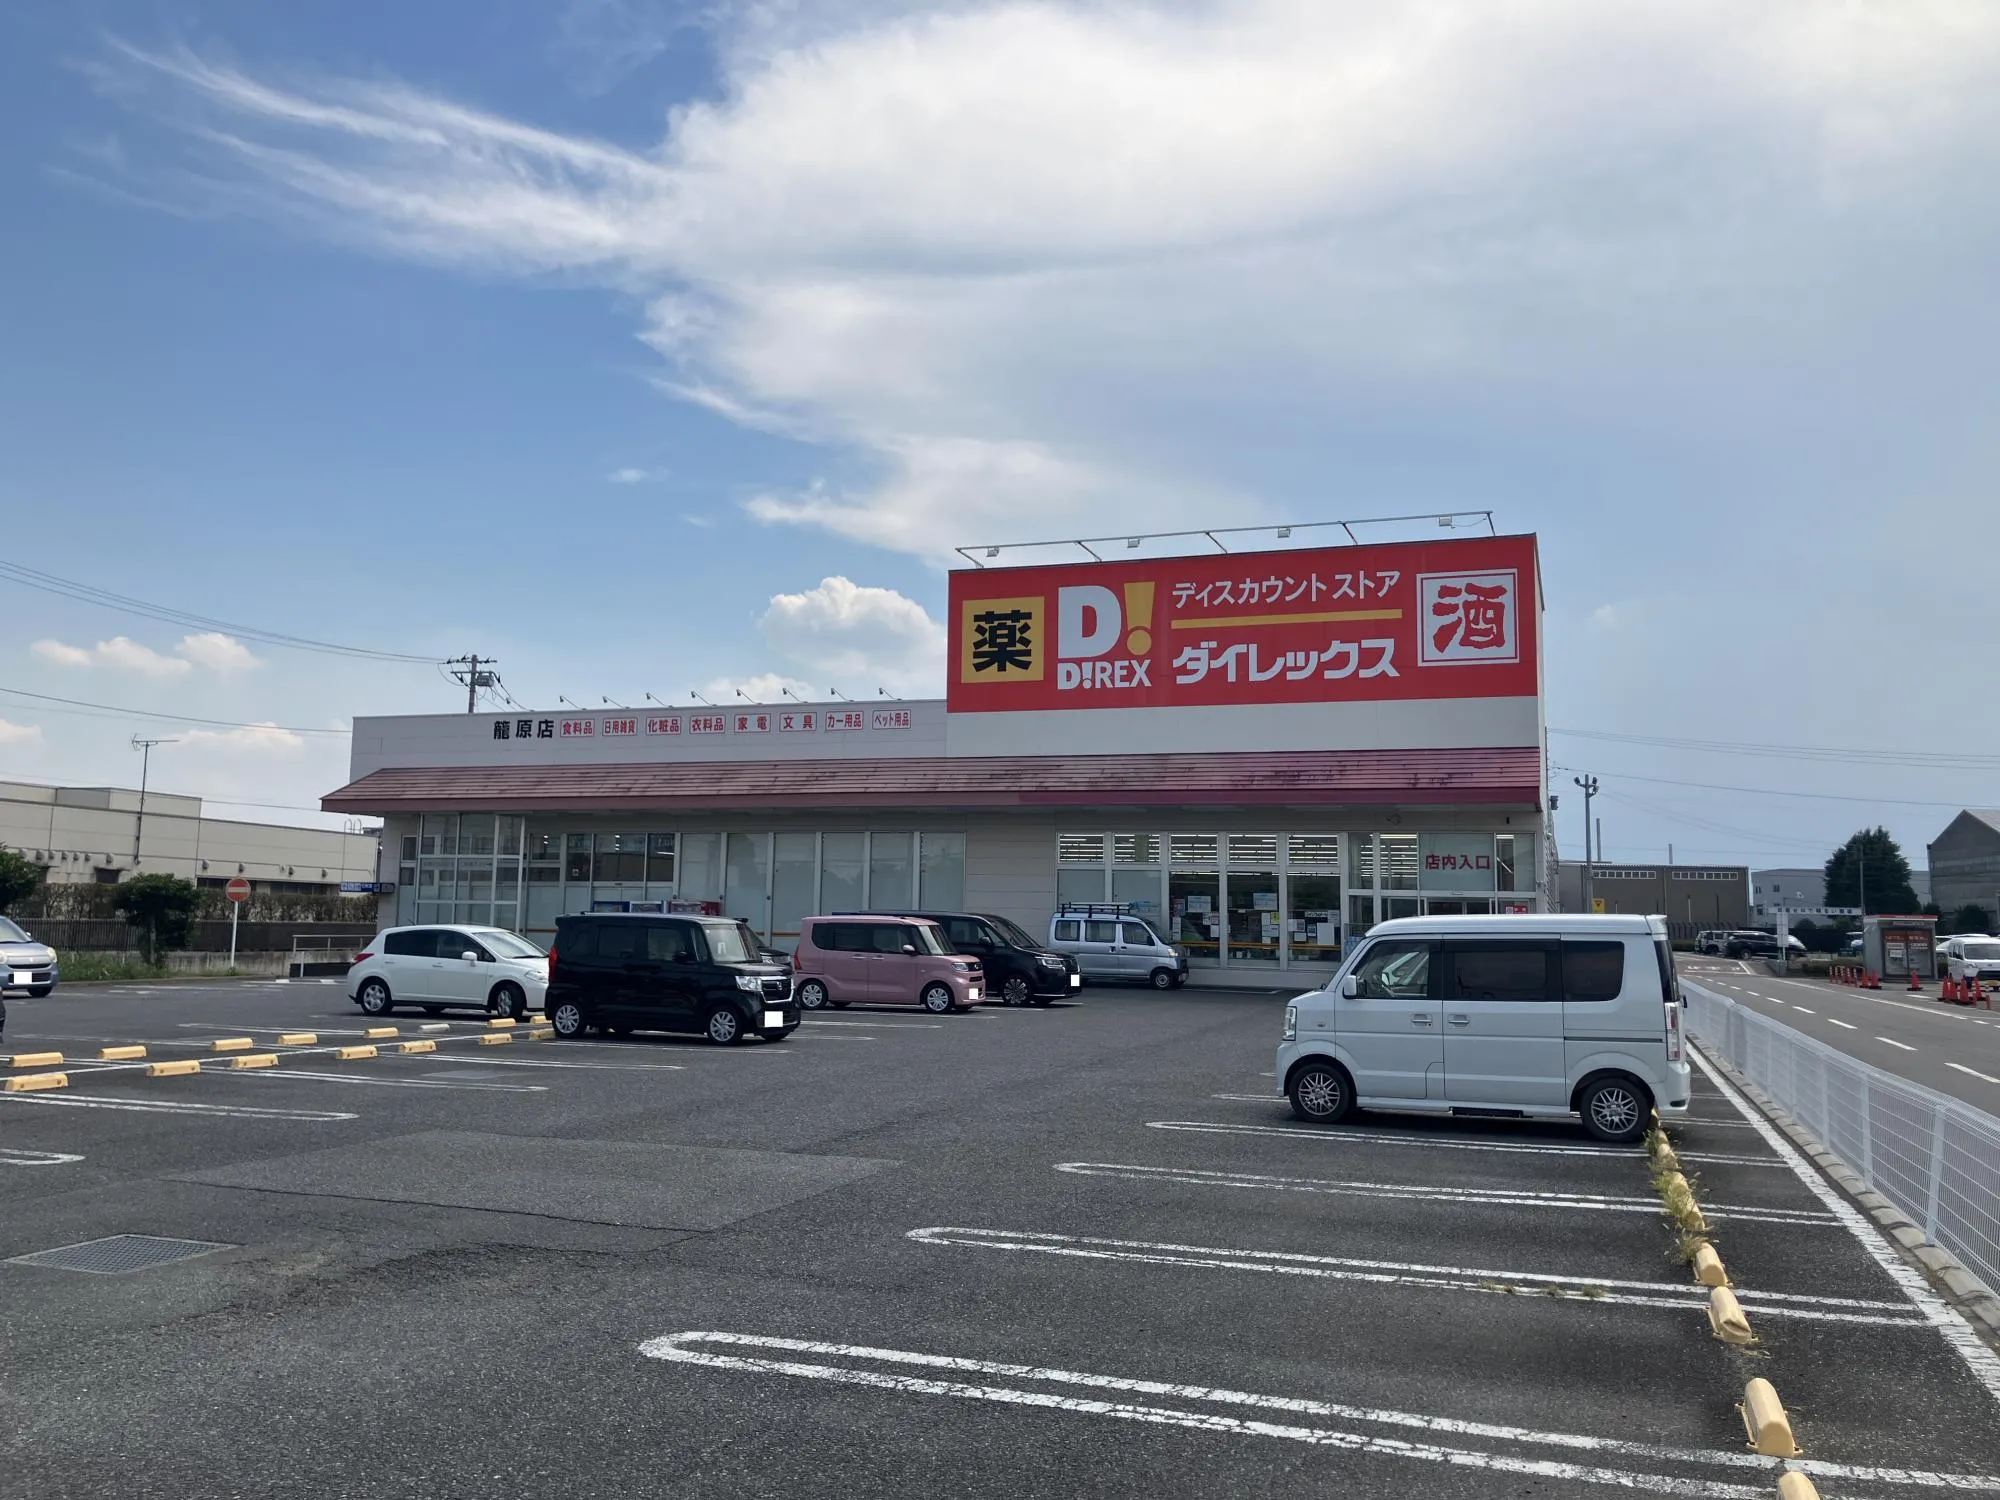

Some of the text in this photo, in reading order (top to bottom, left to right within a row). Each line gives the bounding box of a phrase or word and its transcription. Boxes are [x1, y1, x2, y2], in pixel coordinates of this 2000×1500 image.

[1172, 569, 1401, 610] ディスカウント ストア
[1432, 582, 1508, 654] 酒
[973, 610, 1033, 672] 薬
[1172, 638, 1400, 685] ダイレックス
[647, 719, 680, 733] 化粧品
[691, 718, 723, 732] 衣料品
[737, 717, 768, 731] 家電
[783, 715, 814, 729] 文具
[827, 714, 862, 728] カー用品
[874, 712, 909, 727] ペット用品
[493, 719, 555, 740] 籠原店
[563, 722, 593, 735] 食料品
[604, 720, 636, 734] 日用雑貨
[1425, 854, 1491, 870] 店内入口
